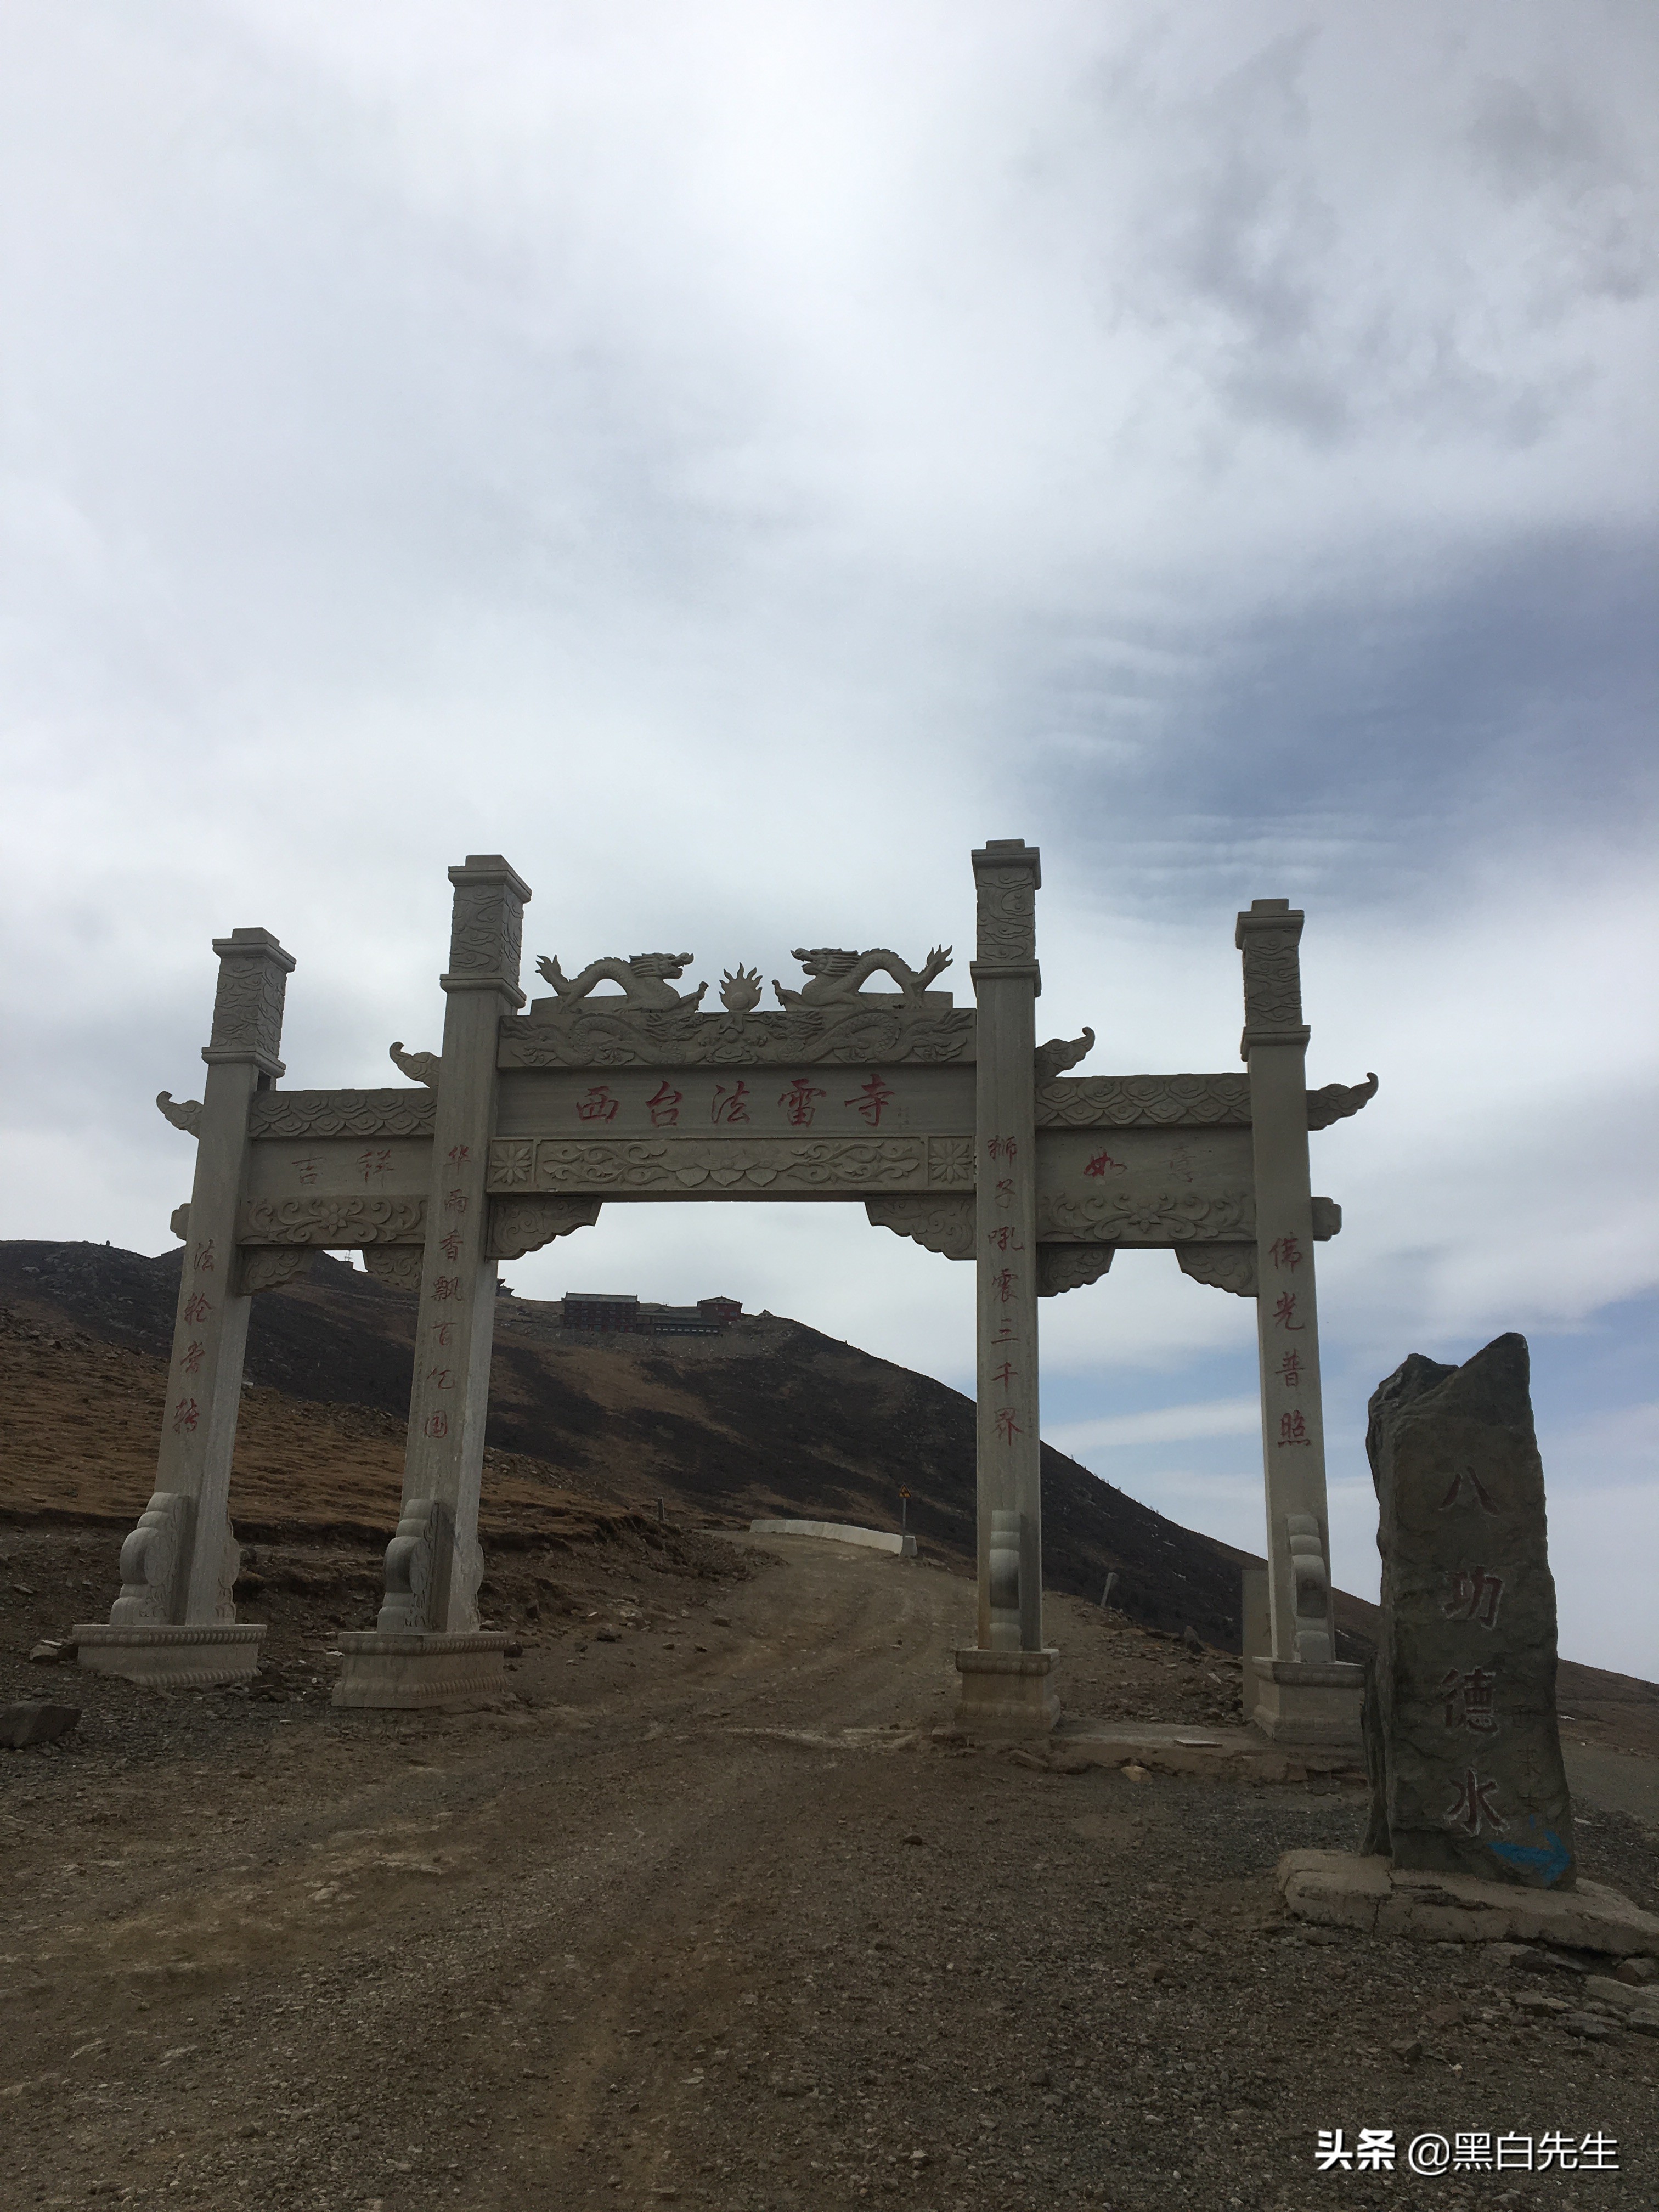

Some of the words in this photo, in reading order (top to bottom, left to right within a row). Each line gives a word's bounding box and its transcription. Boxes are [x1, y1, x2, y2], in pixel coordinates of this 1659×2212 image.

[575, 1073, 895, 1128] 西台法雷寺
[290, 1149, 394, 1188] 吉祥
[1082, 1142, 1198, 1183] 如意
[1269, 1232, 1312, 1448] 佛光普照
[1438, 1466, 1510, 1836] 八功德水
